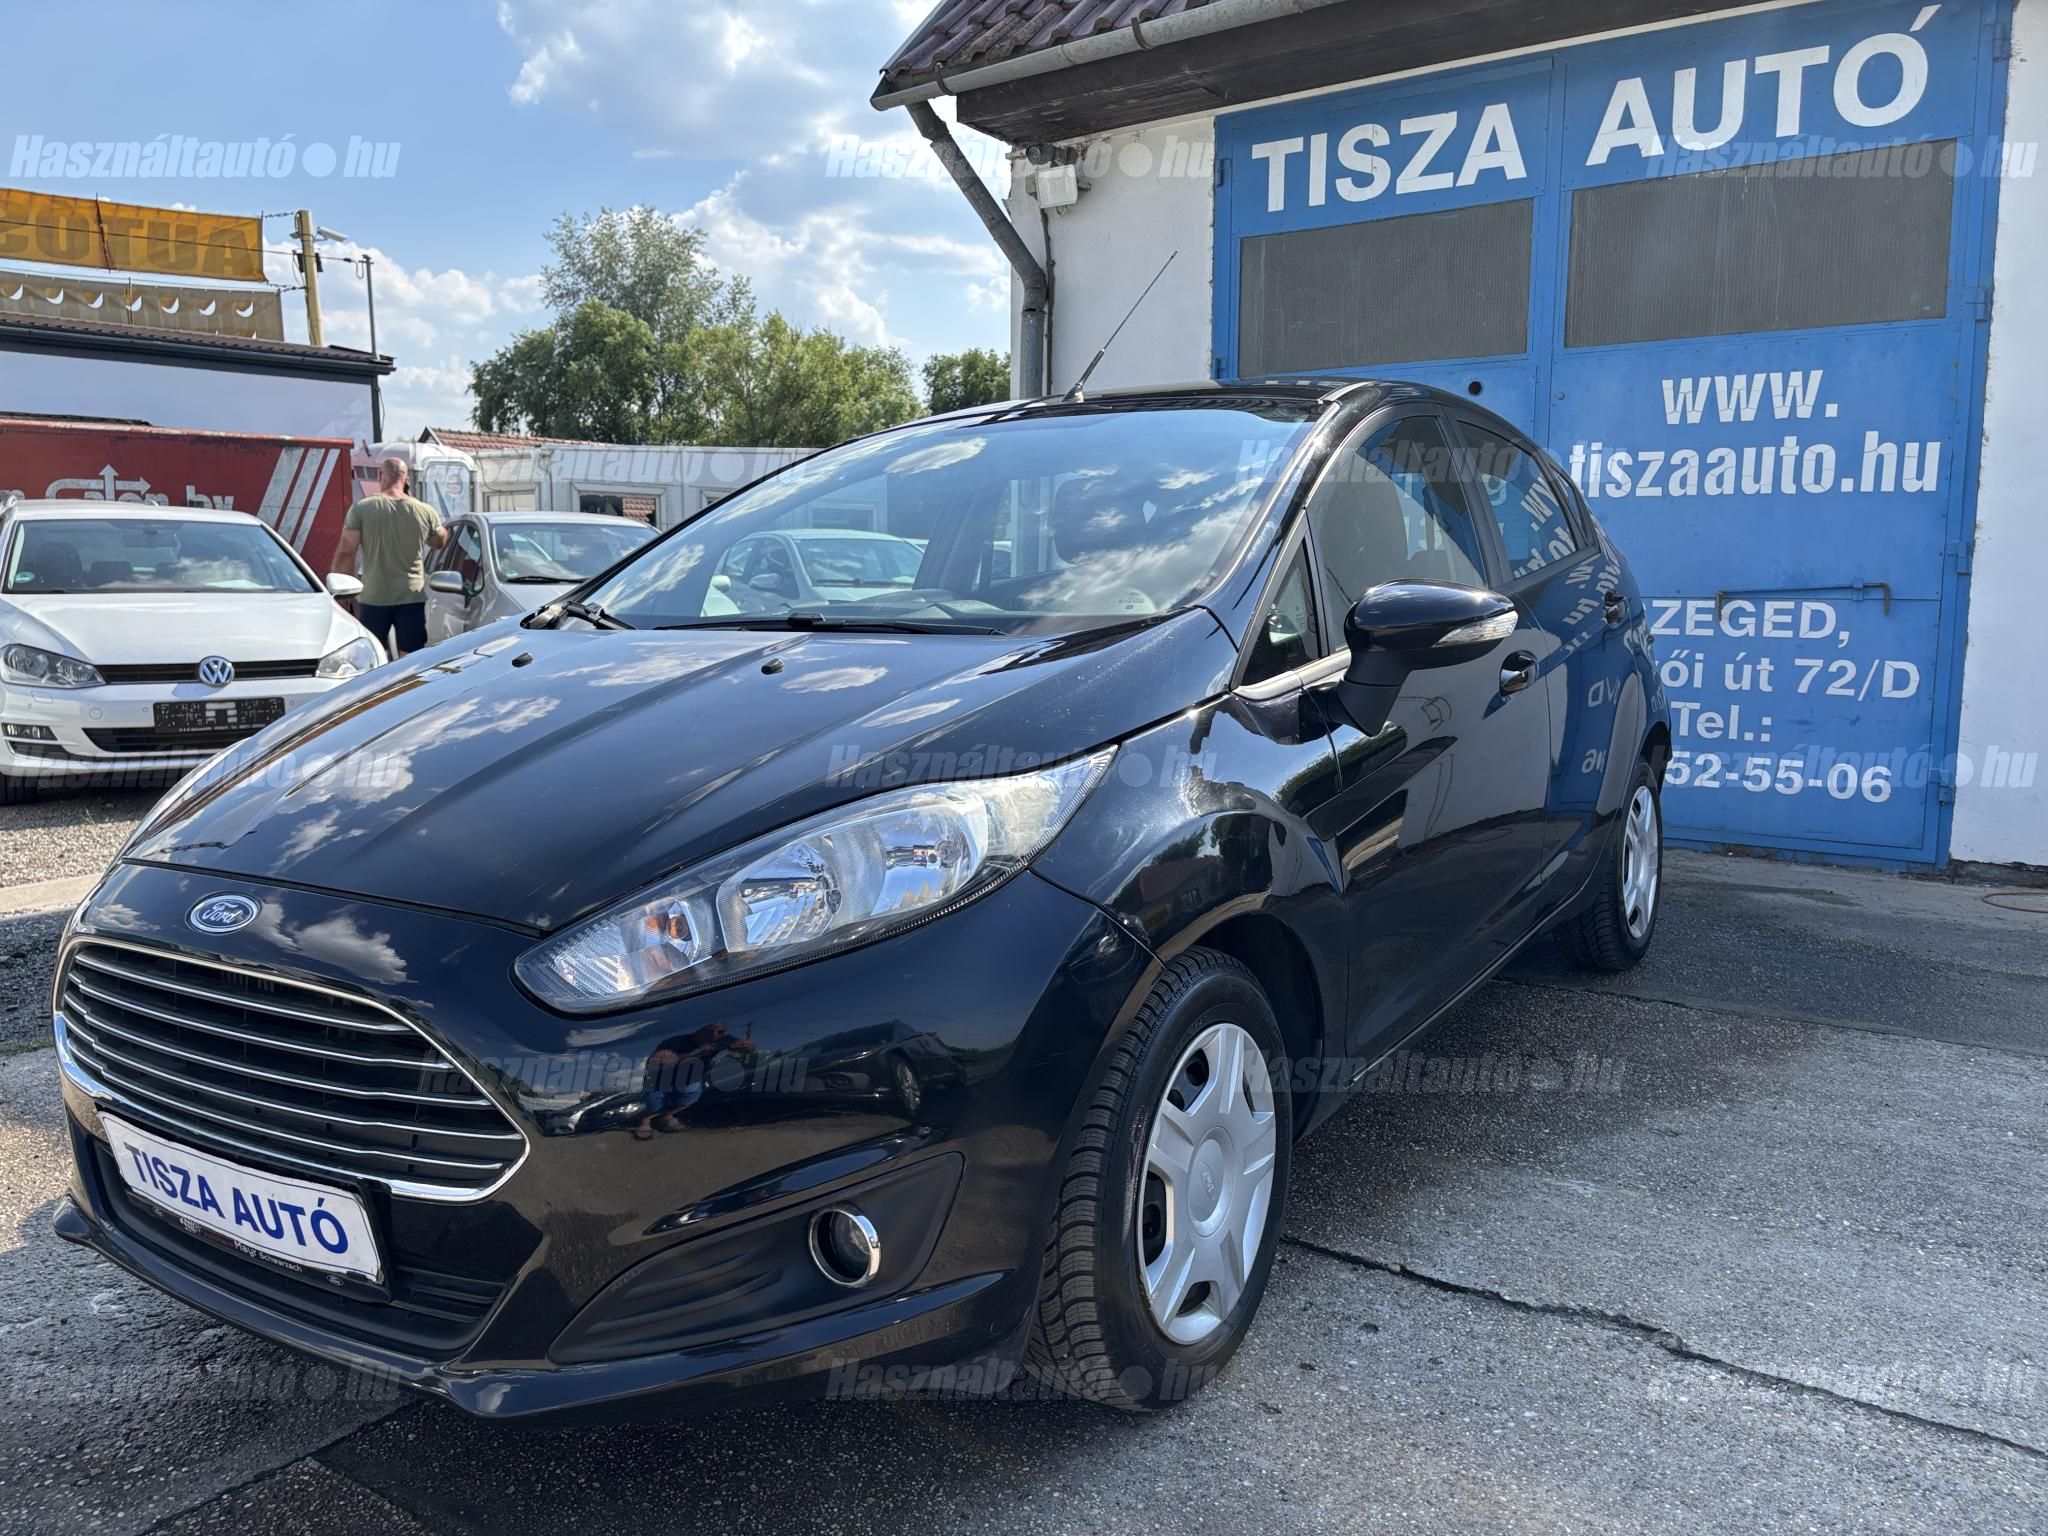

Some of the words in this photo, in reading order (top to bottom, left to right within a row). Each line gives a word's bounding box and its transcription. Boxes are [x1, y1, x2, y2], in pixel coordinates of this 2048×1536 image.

[1252, 102, 1529, 213] TISZA
[1586, 4, 1942, 166] AUTÓ
[1661, 369, 1839, 425] www.
[1569, 430, 1941, 498] tiszaauto.hu
[1649, 599, 1851, 648] ZEGED,
[1655, 650, 1704, 689] ői
[1724, 651, 1775, 692] út
[1794, 658, 1920, 702] 72/D
[1670, 700, 1772, 743] Tel.:
[124, 1142, 226, 1219] TISZA
[232, 1187, 349, 1254] AUTÓ
